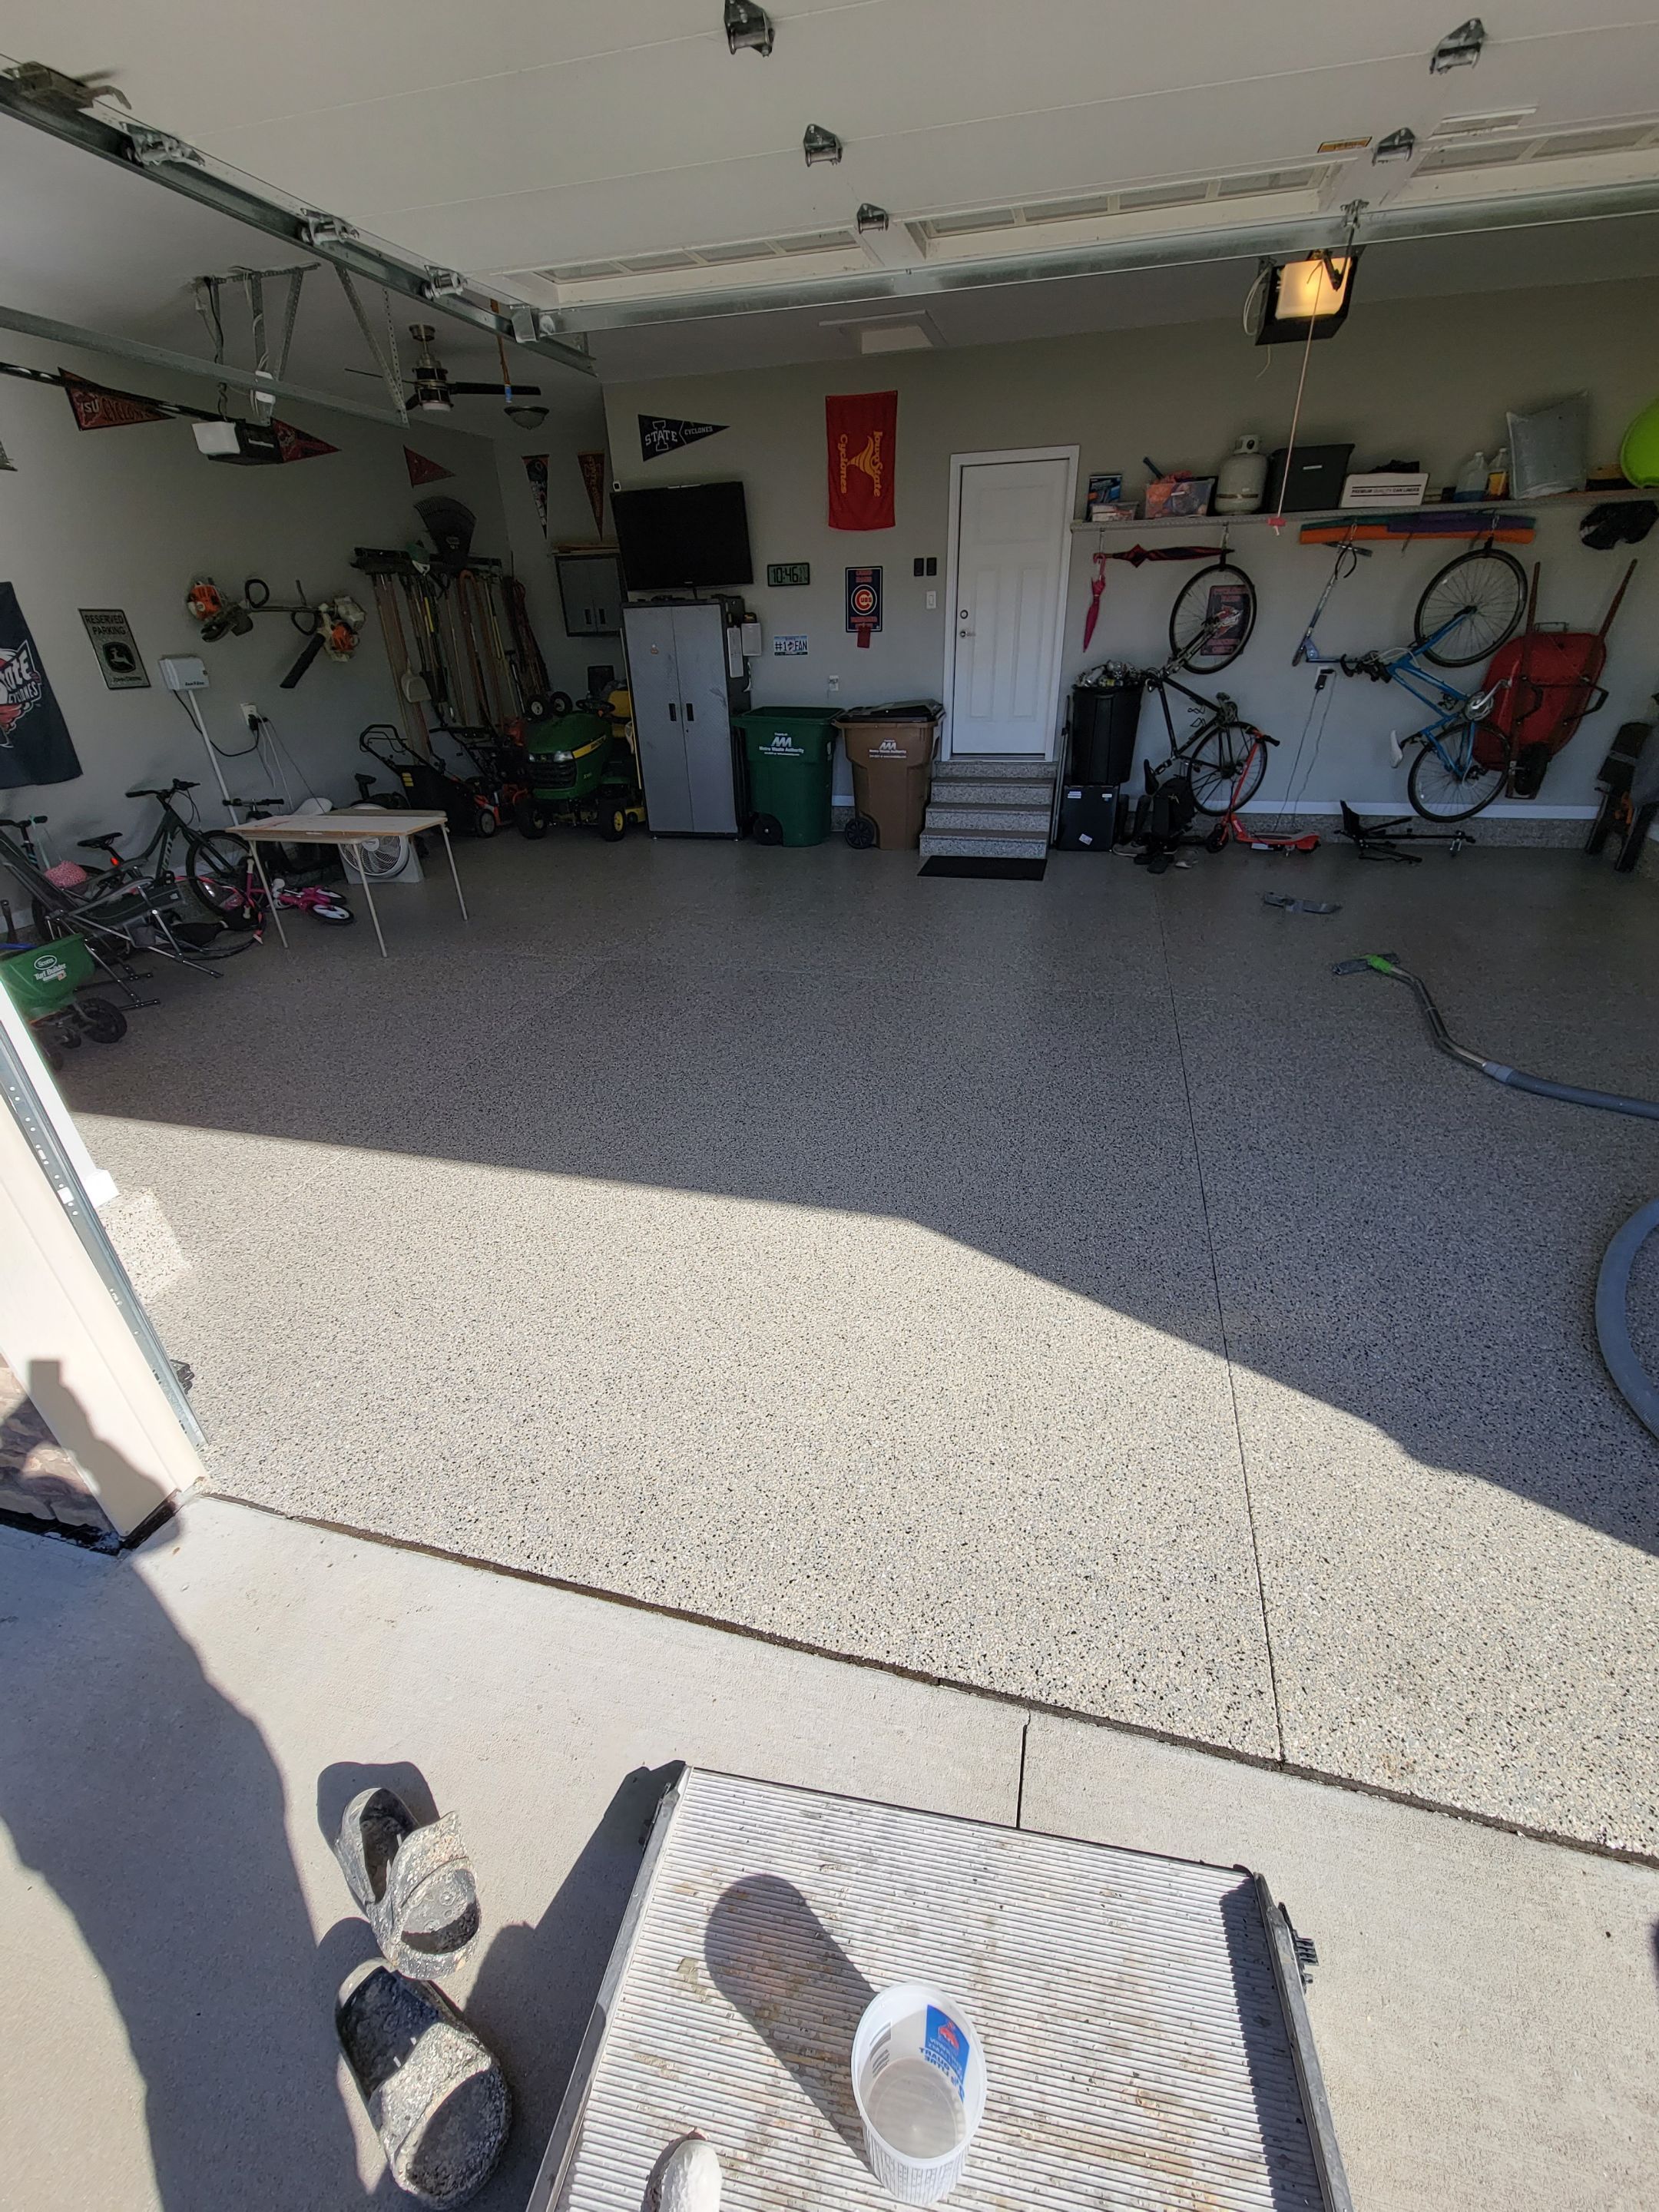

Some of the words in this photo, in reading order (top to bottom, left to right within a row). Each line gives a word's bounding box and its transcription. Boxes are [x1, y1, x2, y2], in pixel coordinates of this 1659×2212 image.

[684, 426, 713, 435] CYCLONES
[645, 429, 678, 446] STATE
[838, 432, 848, 494] Cyclones
[773, 566, 799, 584] 10:46
[84, 615, 124, 624] RESERVED
[92, 627, 126, 635] PARKING
[775, 641, 787, 651] #1
[794, 640, 808, 651] FAN
[38, 957, 55, 968] Scotts
[34, 971, 46, 981] Turf
[46, 963, 66, 975] Builder
